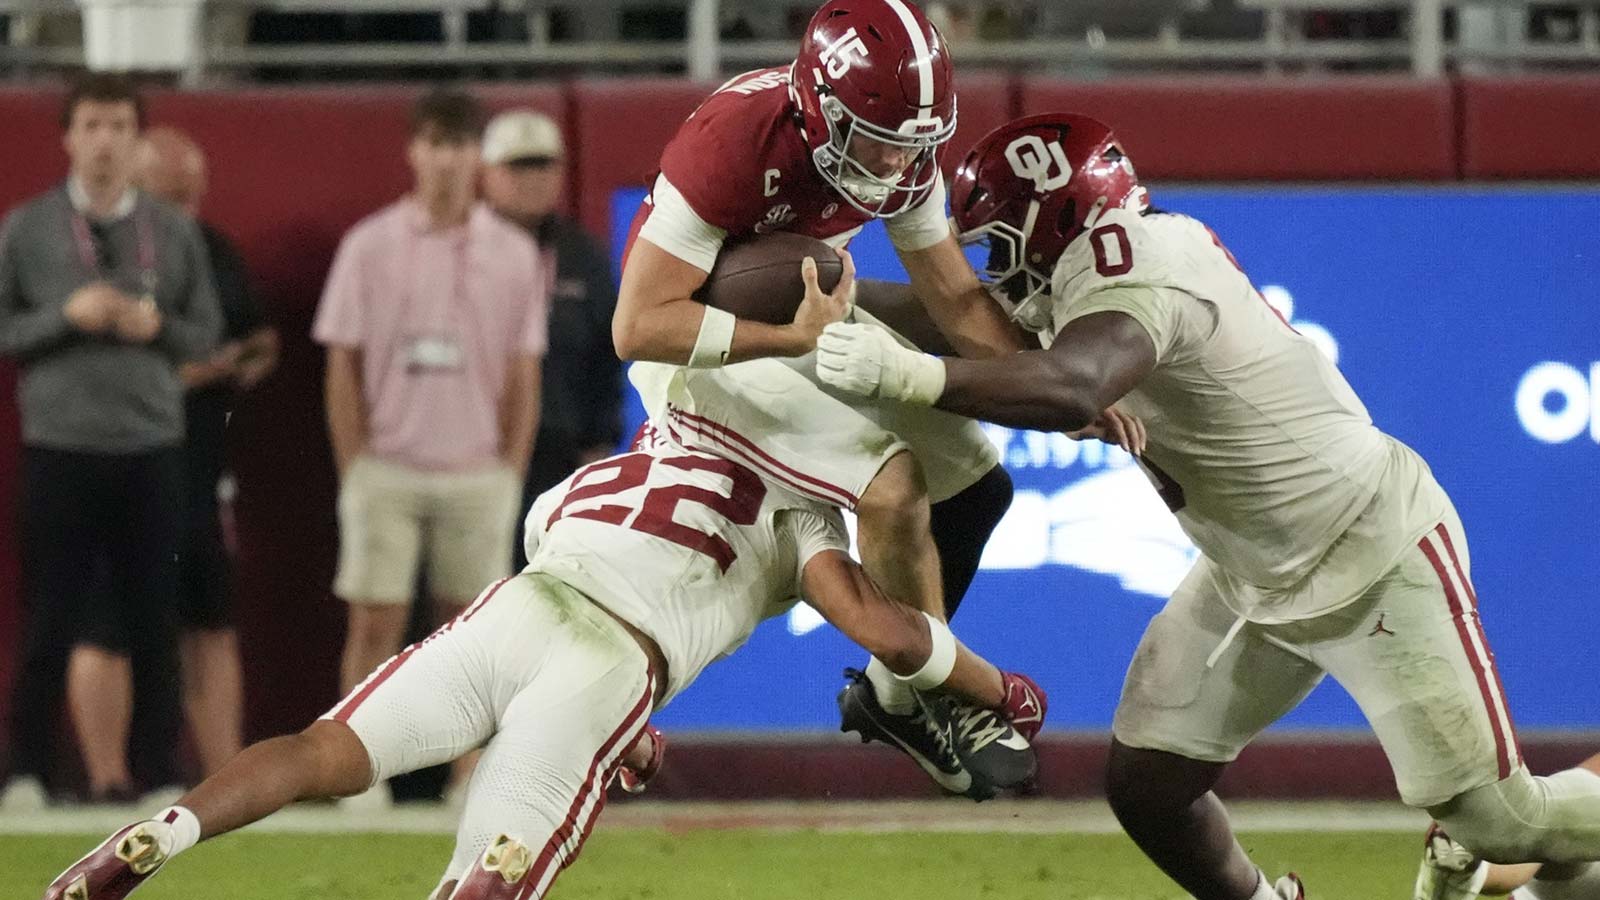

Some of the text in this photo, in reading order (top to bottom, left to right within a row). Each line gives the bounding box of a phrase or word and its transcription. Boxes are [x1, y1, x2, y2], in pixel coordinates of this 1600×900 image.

[819, 27, 869, 79] 15
[764, 168, 781, 197] C
[1004, 135, 1073, 194] OU
[546, 453, 767, 575] 22
